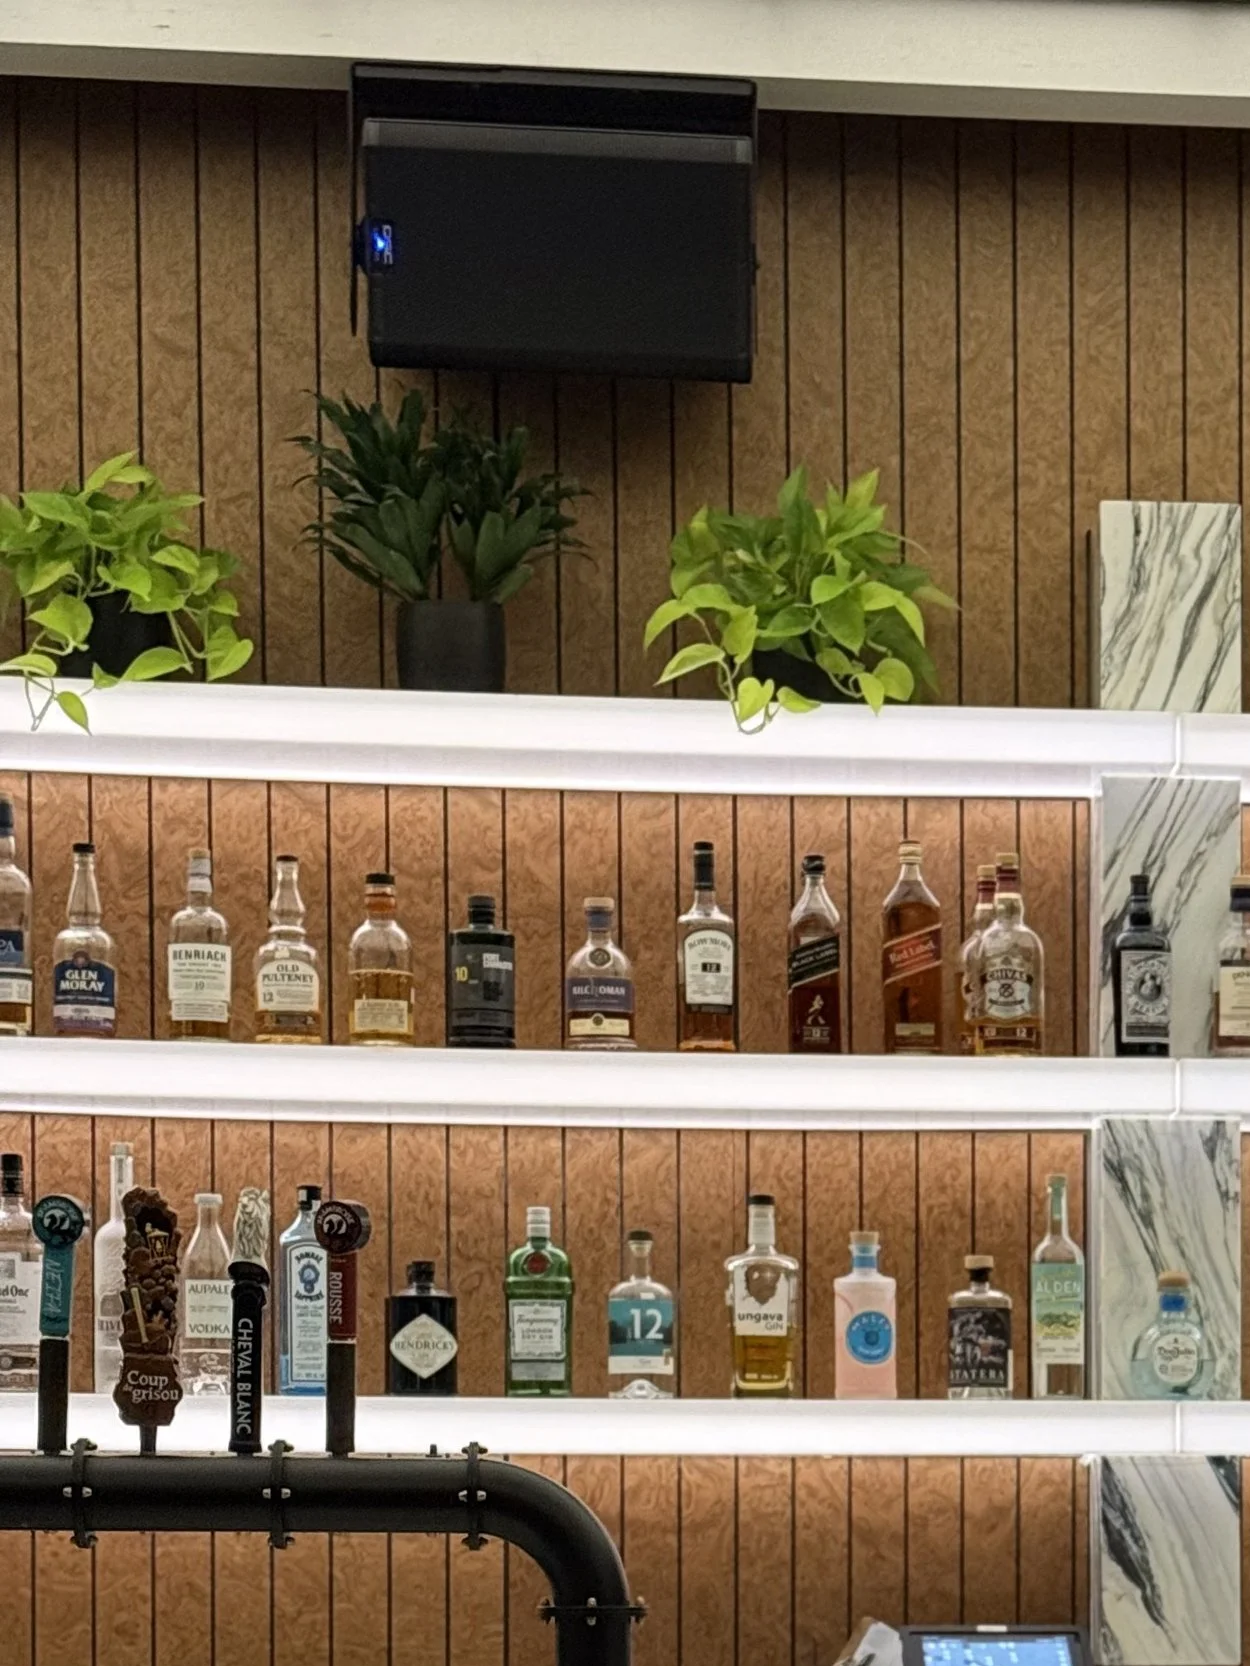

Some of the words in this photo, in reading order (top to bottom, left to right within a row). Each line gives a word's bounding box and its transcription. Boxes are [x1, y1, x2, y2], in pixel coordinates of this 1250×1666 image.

[173, 949, 227, 962] BENRIACH
[65, 969, 98, 981] GLEN
[276, 964, 300, 973] OLD
[455, 965, 468, 982] 10
[986, 968, 1028, 981] CHIVAS
[262, 973, 314, 984] PULTENEY
[59, 979, 105, 993] MORAY
[329, 1271, 343, 1325] ROUSSE
[630, 1307, 665, 1340] 12
[737, 1312, 783, 1323] ungava
[188, 1323, 231, 1334] VODKA
[765, 1321, 784, 1331] GIN
[236, 1317, 254, 1378] CHEVAL
[127, 1370, 169, 1390] Coup
[131, 1387, 179, 1404] grisou
[235, 1382, 253, 1435] BLANC
